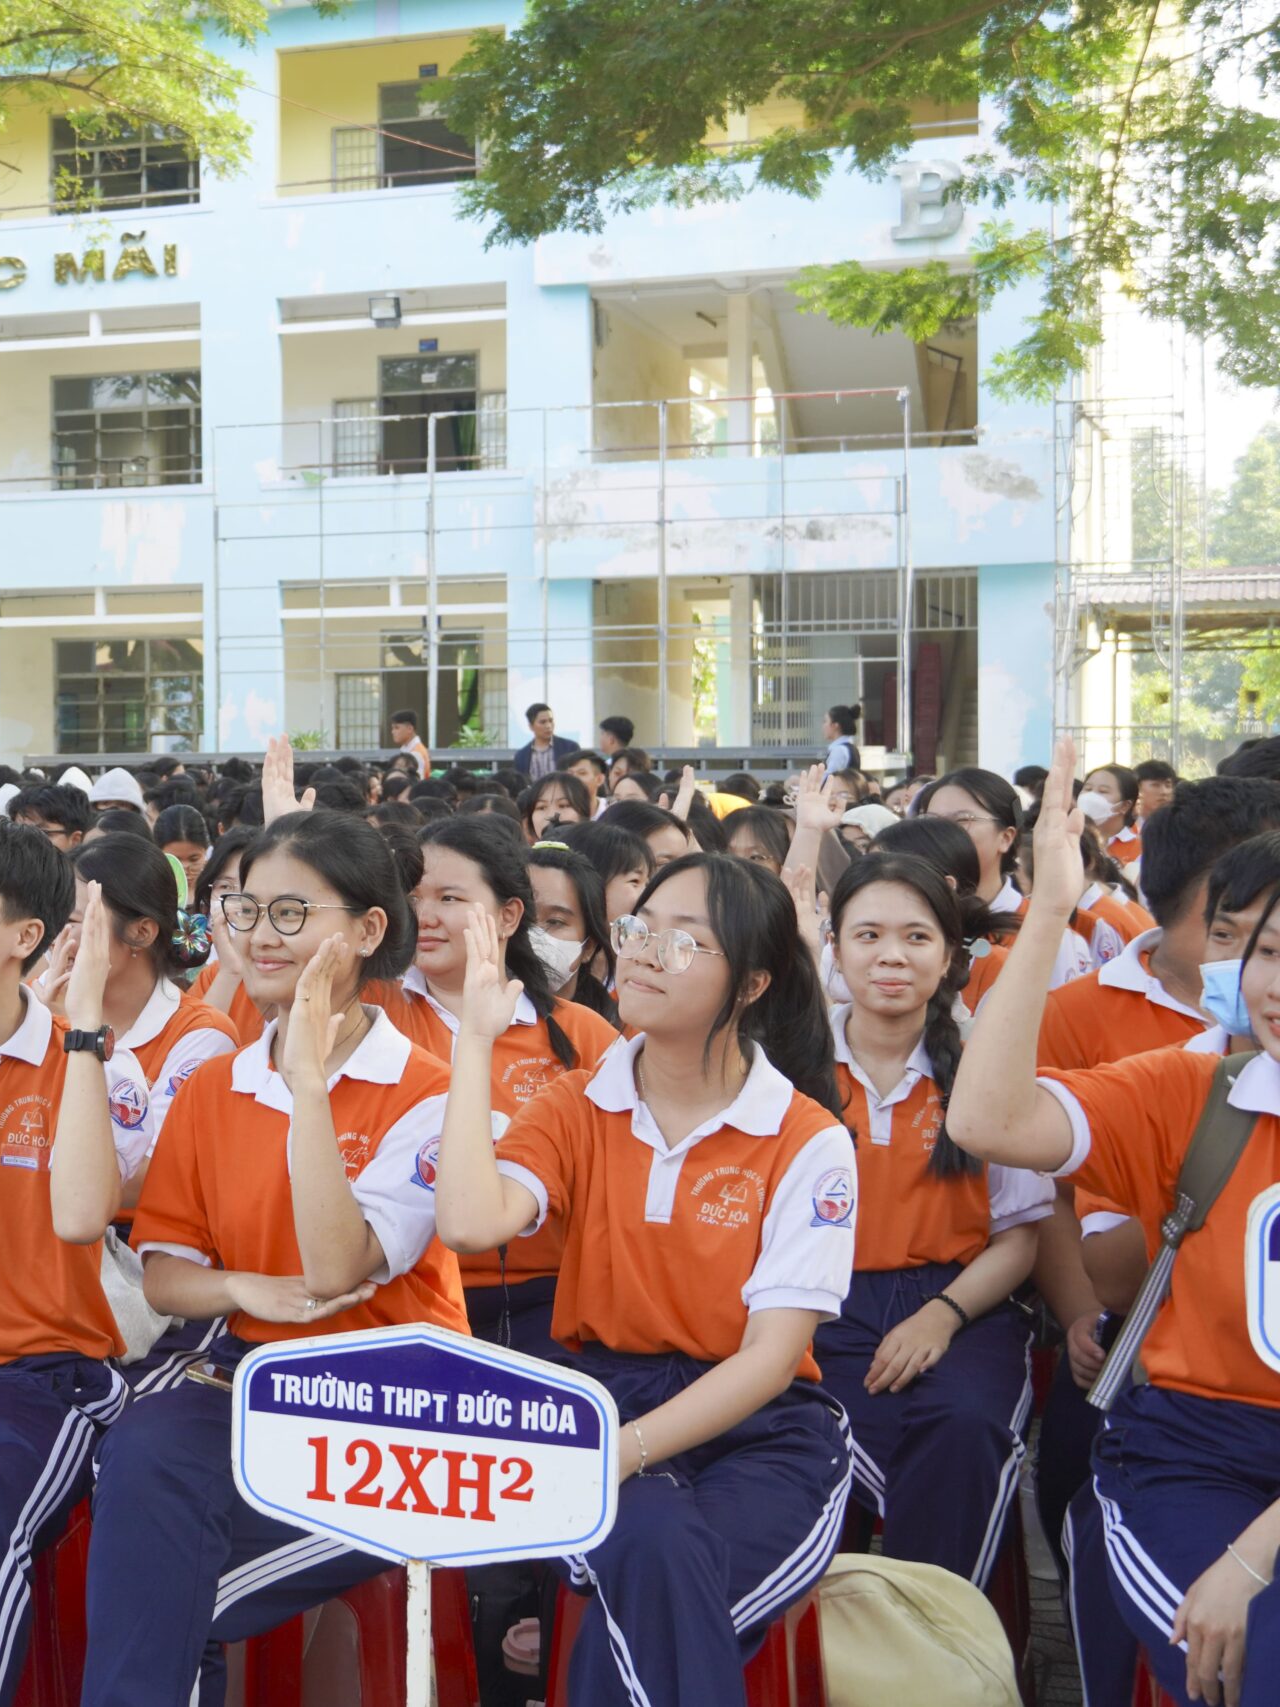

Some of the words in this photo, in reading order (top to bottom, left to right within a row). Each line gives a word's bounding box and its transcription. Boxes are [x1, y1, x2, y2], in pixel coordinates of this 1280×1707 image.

[891, 159, 964, 241] B
[54, 230, 178, 285] MÃI
[7, 1131, 30, 1145] ĐỨC
[715, 1165, 741, 1177] TRUNG
[700, 1201, 728, 1220] ĐỨC
[727, 1208, 750, 1225] HÒA
[270, 1371, 373, 1413] TRƯỜNG
[381, 1384, 449, 1423] THPT
[456, 1388, 513, 1428] ĐỨC
[520, 1395, 578, 1435] HÒA
[306, 1436, 535, 1522] 12XH2
